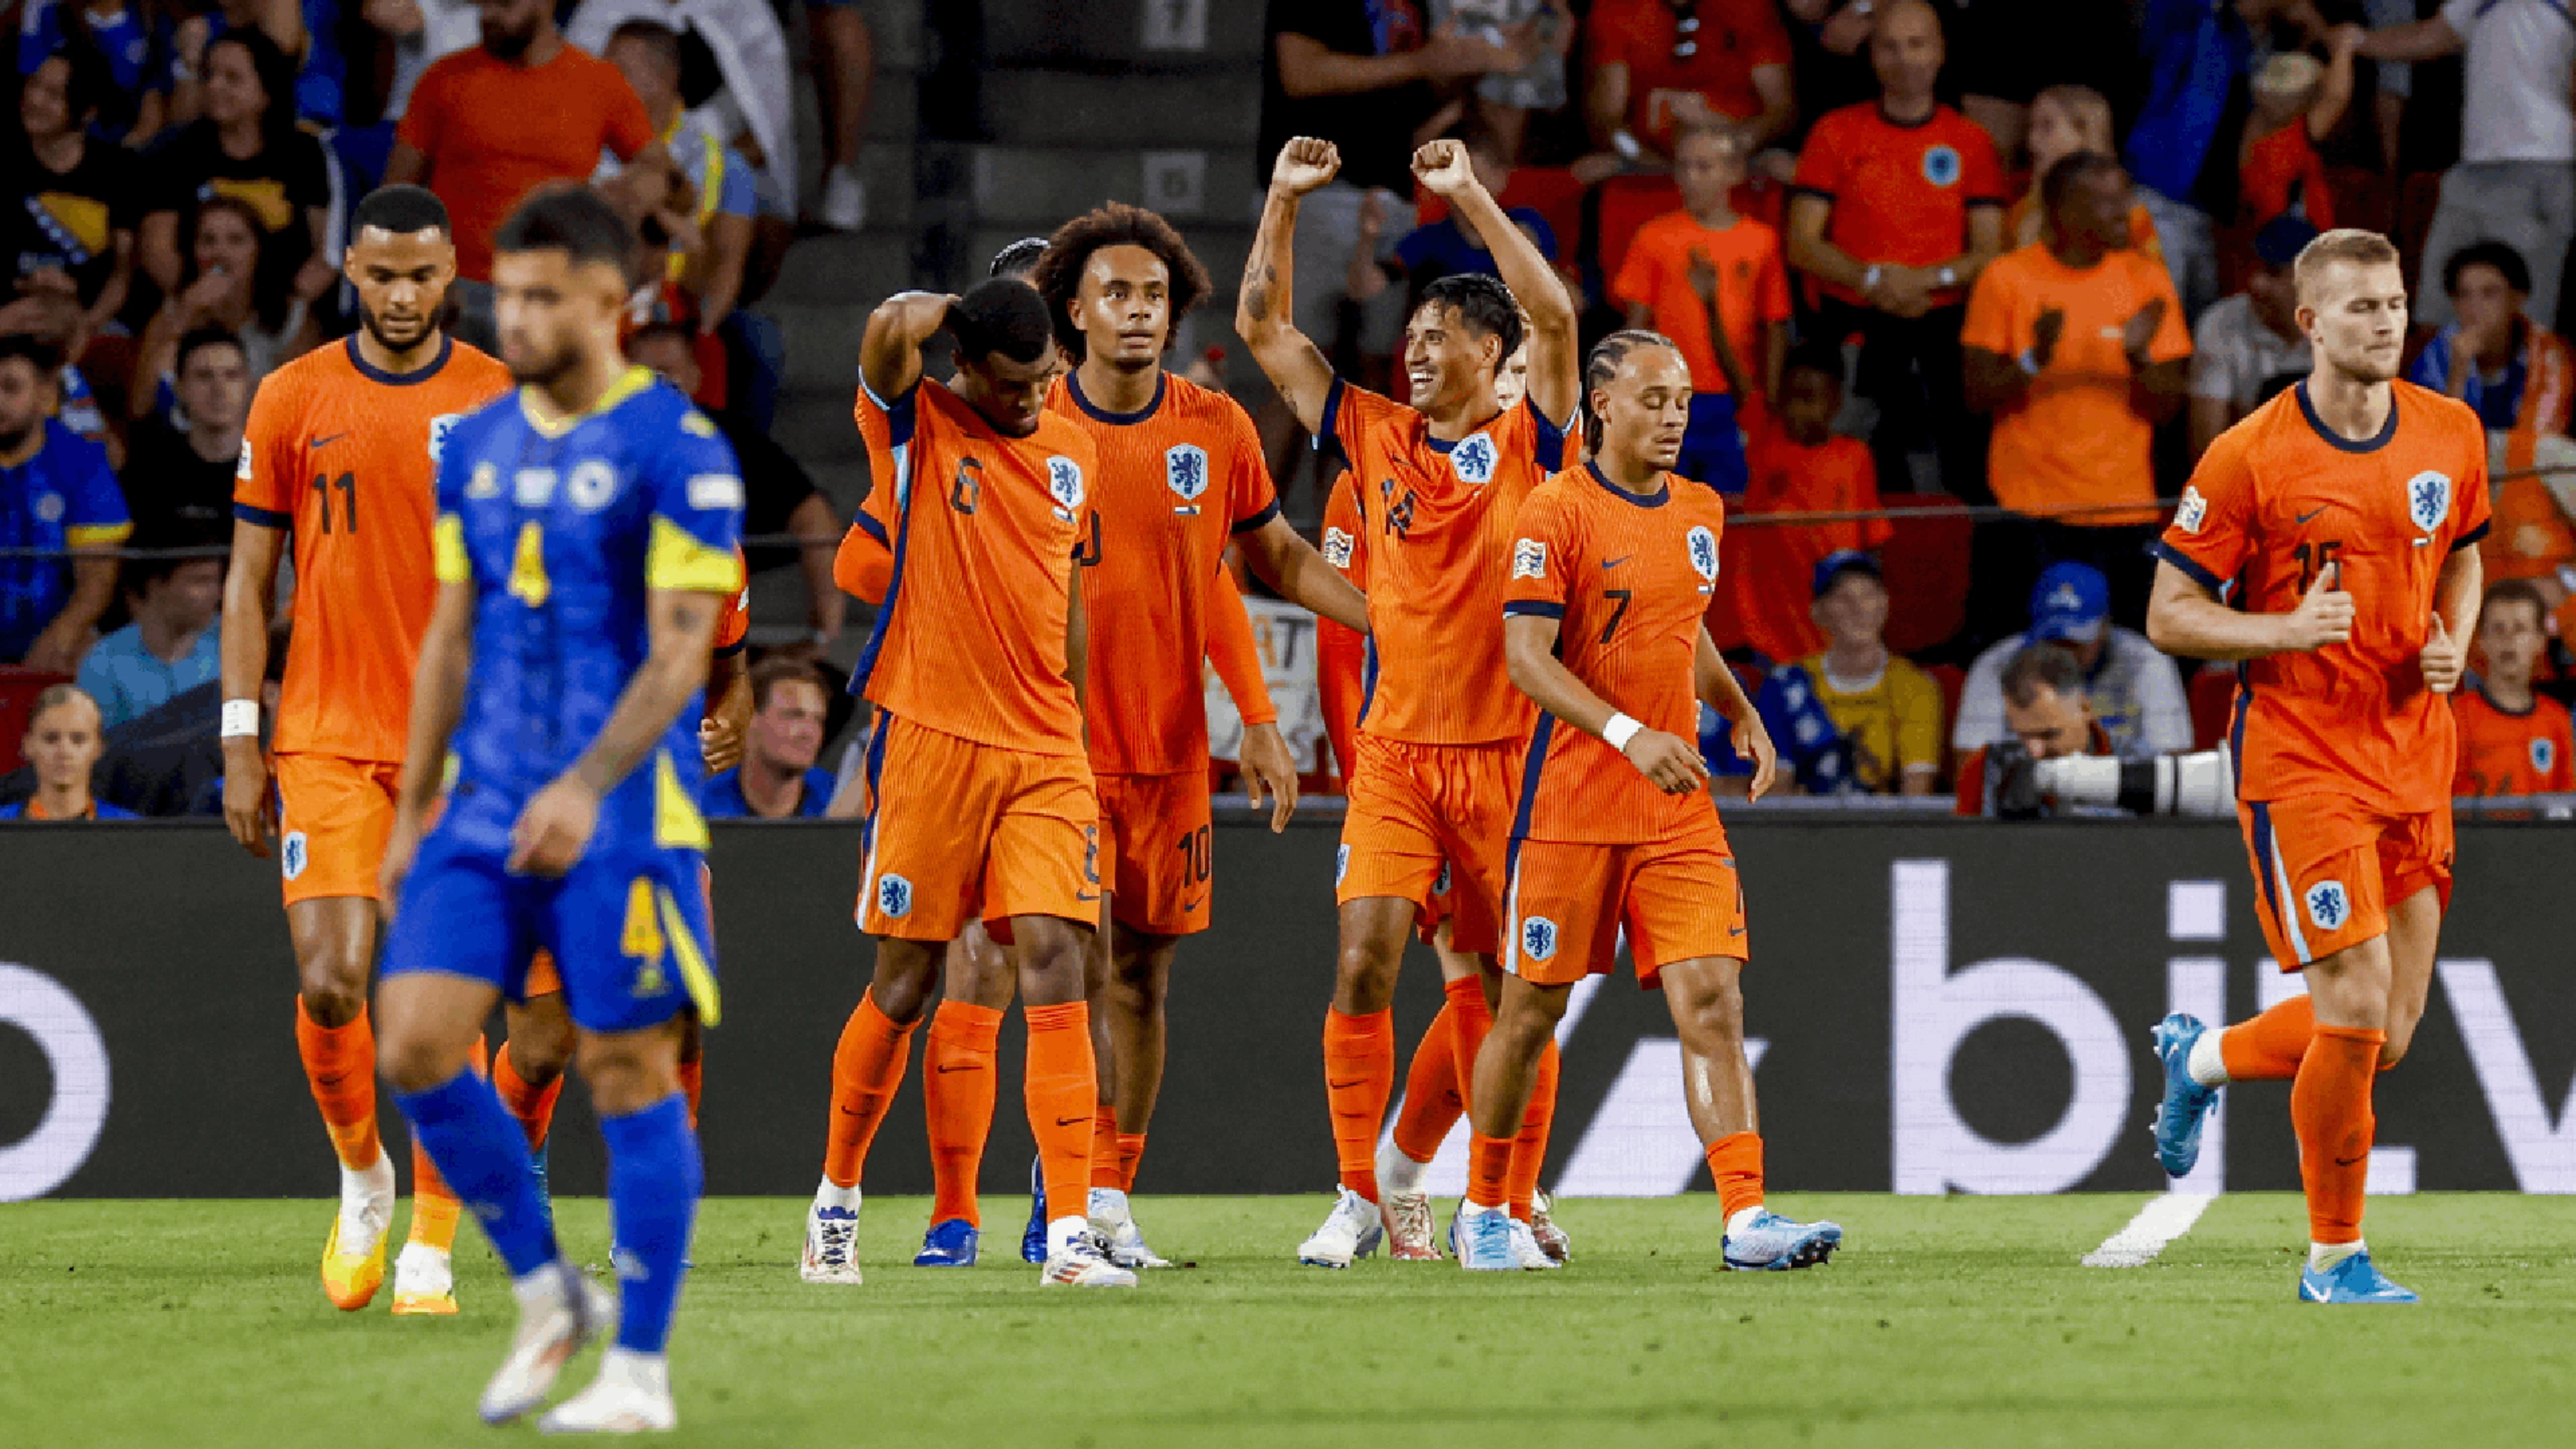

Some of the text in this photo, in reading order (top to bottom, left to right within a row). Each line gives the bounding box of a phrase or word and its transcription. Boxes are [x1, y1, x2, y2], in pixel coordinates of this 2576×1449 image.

[311, 471, 357, 534] 11
[951, 455, 982, 515] 6
[508, 519, 551, 608] 4
[1601, 590, 1631, 644] 7
[1177, 824, 1212, 888] 10
[621, 875, 664, 962] 4
